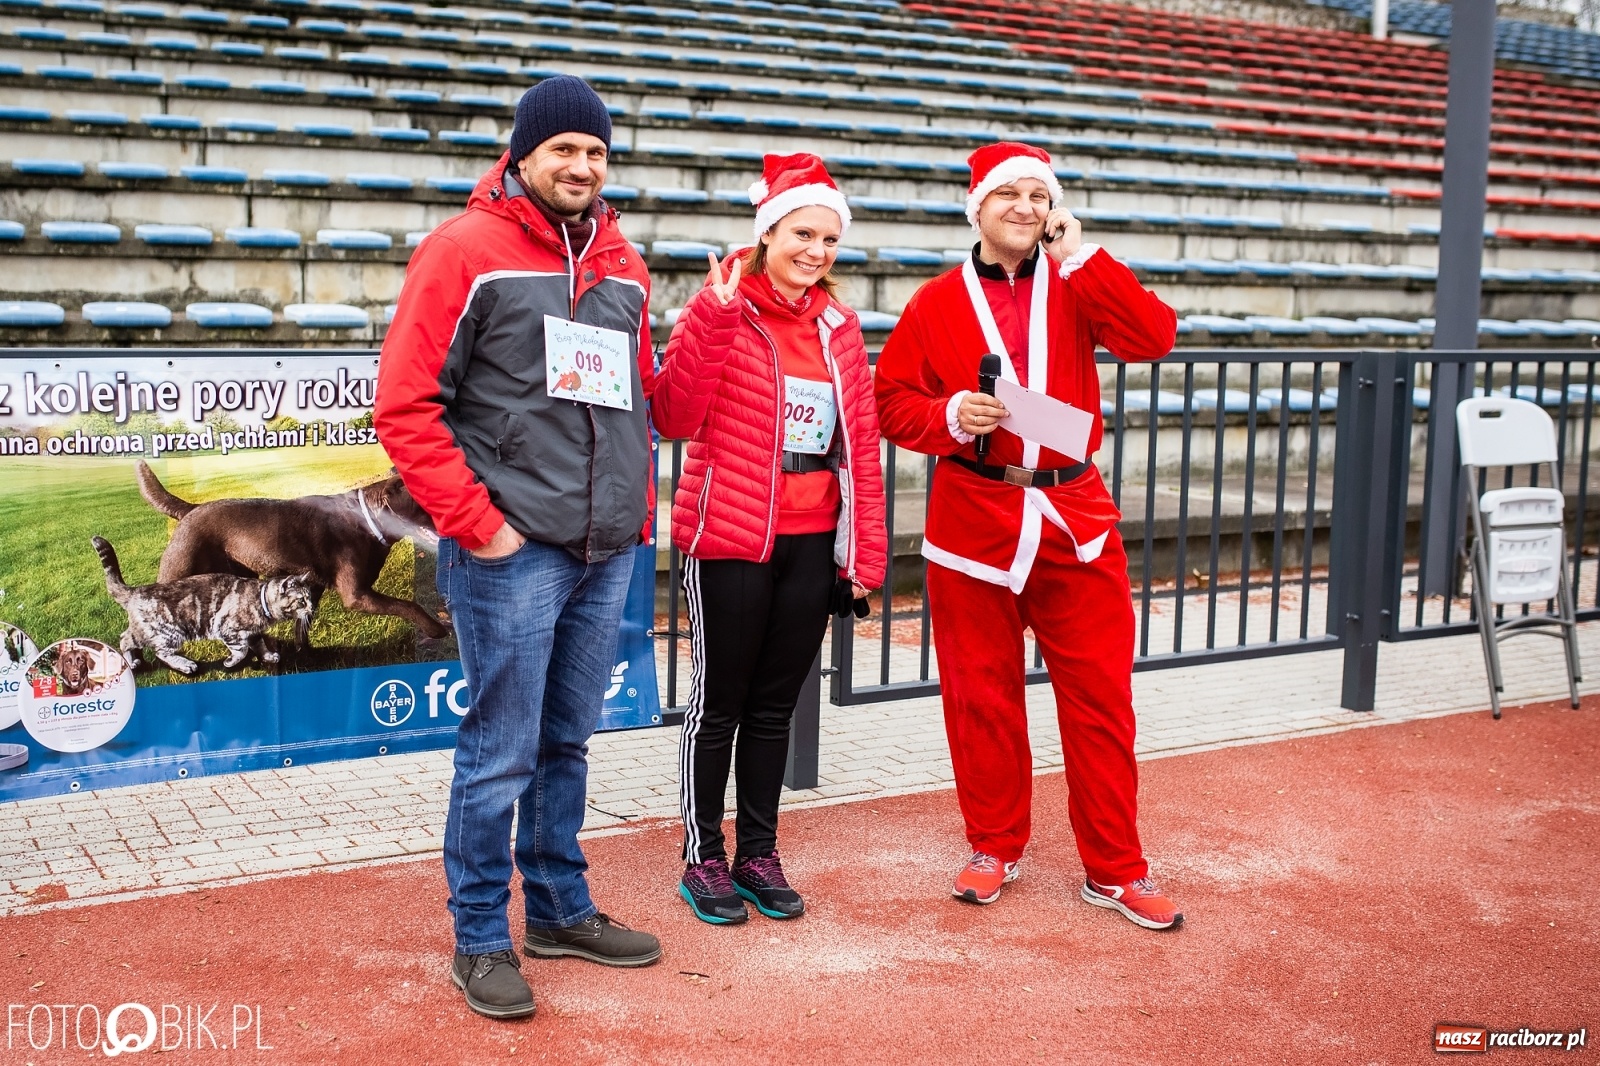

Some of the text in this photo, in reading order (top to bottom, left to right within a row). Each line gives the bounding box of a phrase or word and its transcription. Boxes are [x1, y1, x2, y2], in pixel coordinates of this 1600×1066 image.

[575, 350, 603, 373] 019
[25, 371, 179, 423] kolejne
[193, 379, 285, 421] pory
[299, 368, 377, 407] roku
[785, 402, 815, 424] 002
[47, 430, 144, 454] ochrona
[152, 427, 213, 457] przed
[220, 422, 305, 455] pchłami
[313, 423, 319, 445] i
[326, 422, 379, 445] klesz
[53, 699, 116, 716] foresto
[375, 697, 412, 709] BAYER
[389, 684, 398, 722] BAYER
